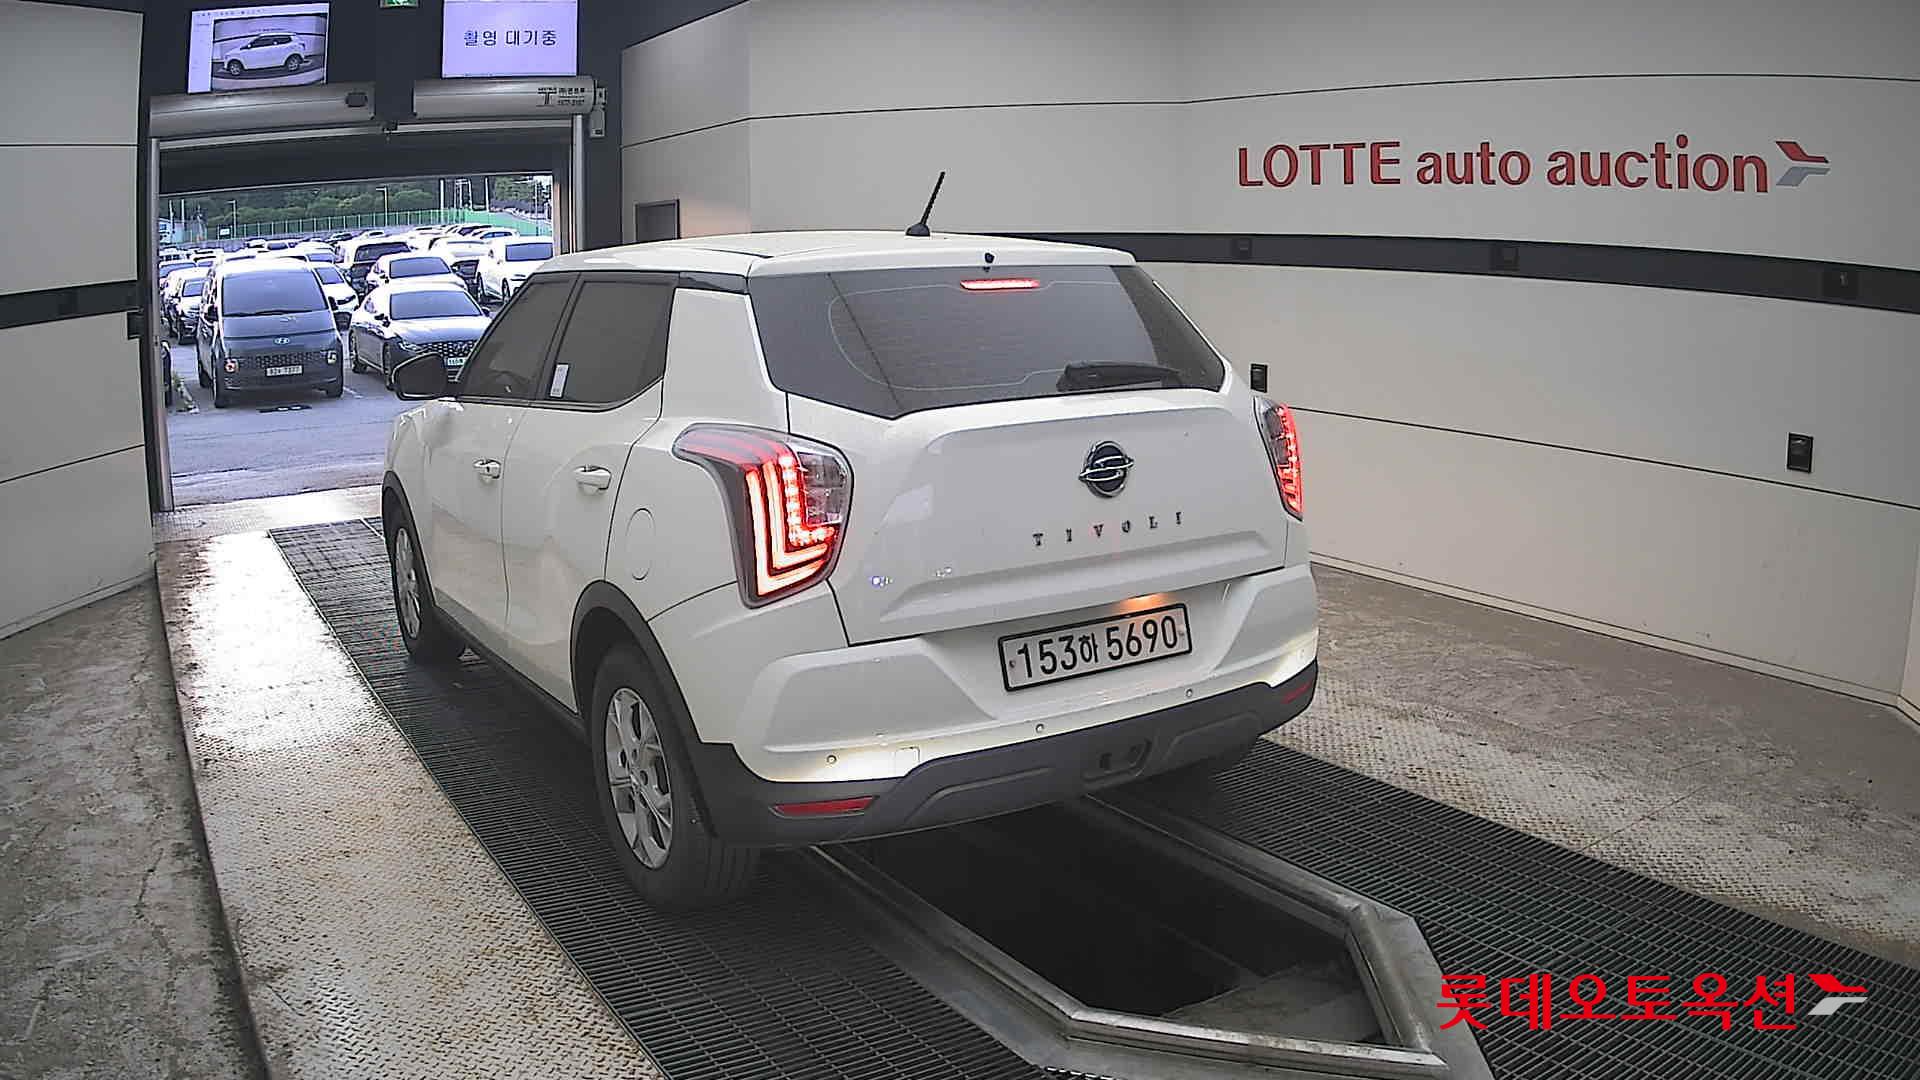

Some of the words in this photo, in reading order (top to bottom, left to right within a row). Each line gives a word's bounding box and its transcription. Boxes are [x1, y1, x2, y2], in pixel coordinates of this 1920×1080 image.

[505, 30, 557, 46] 대기중
[1238, 141, 1400, 187] LOTTE
[1416, 141, 1531, 186] auto
[1546, 133, 1769, 193] auction
[1032, 511, 1182, 546] TIVOLI
[1017, 632, 1099, 678] 153하
[1105, 615, 1178, 661] 5690
